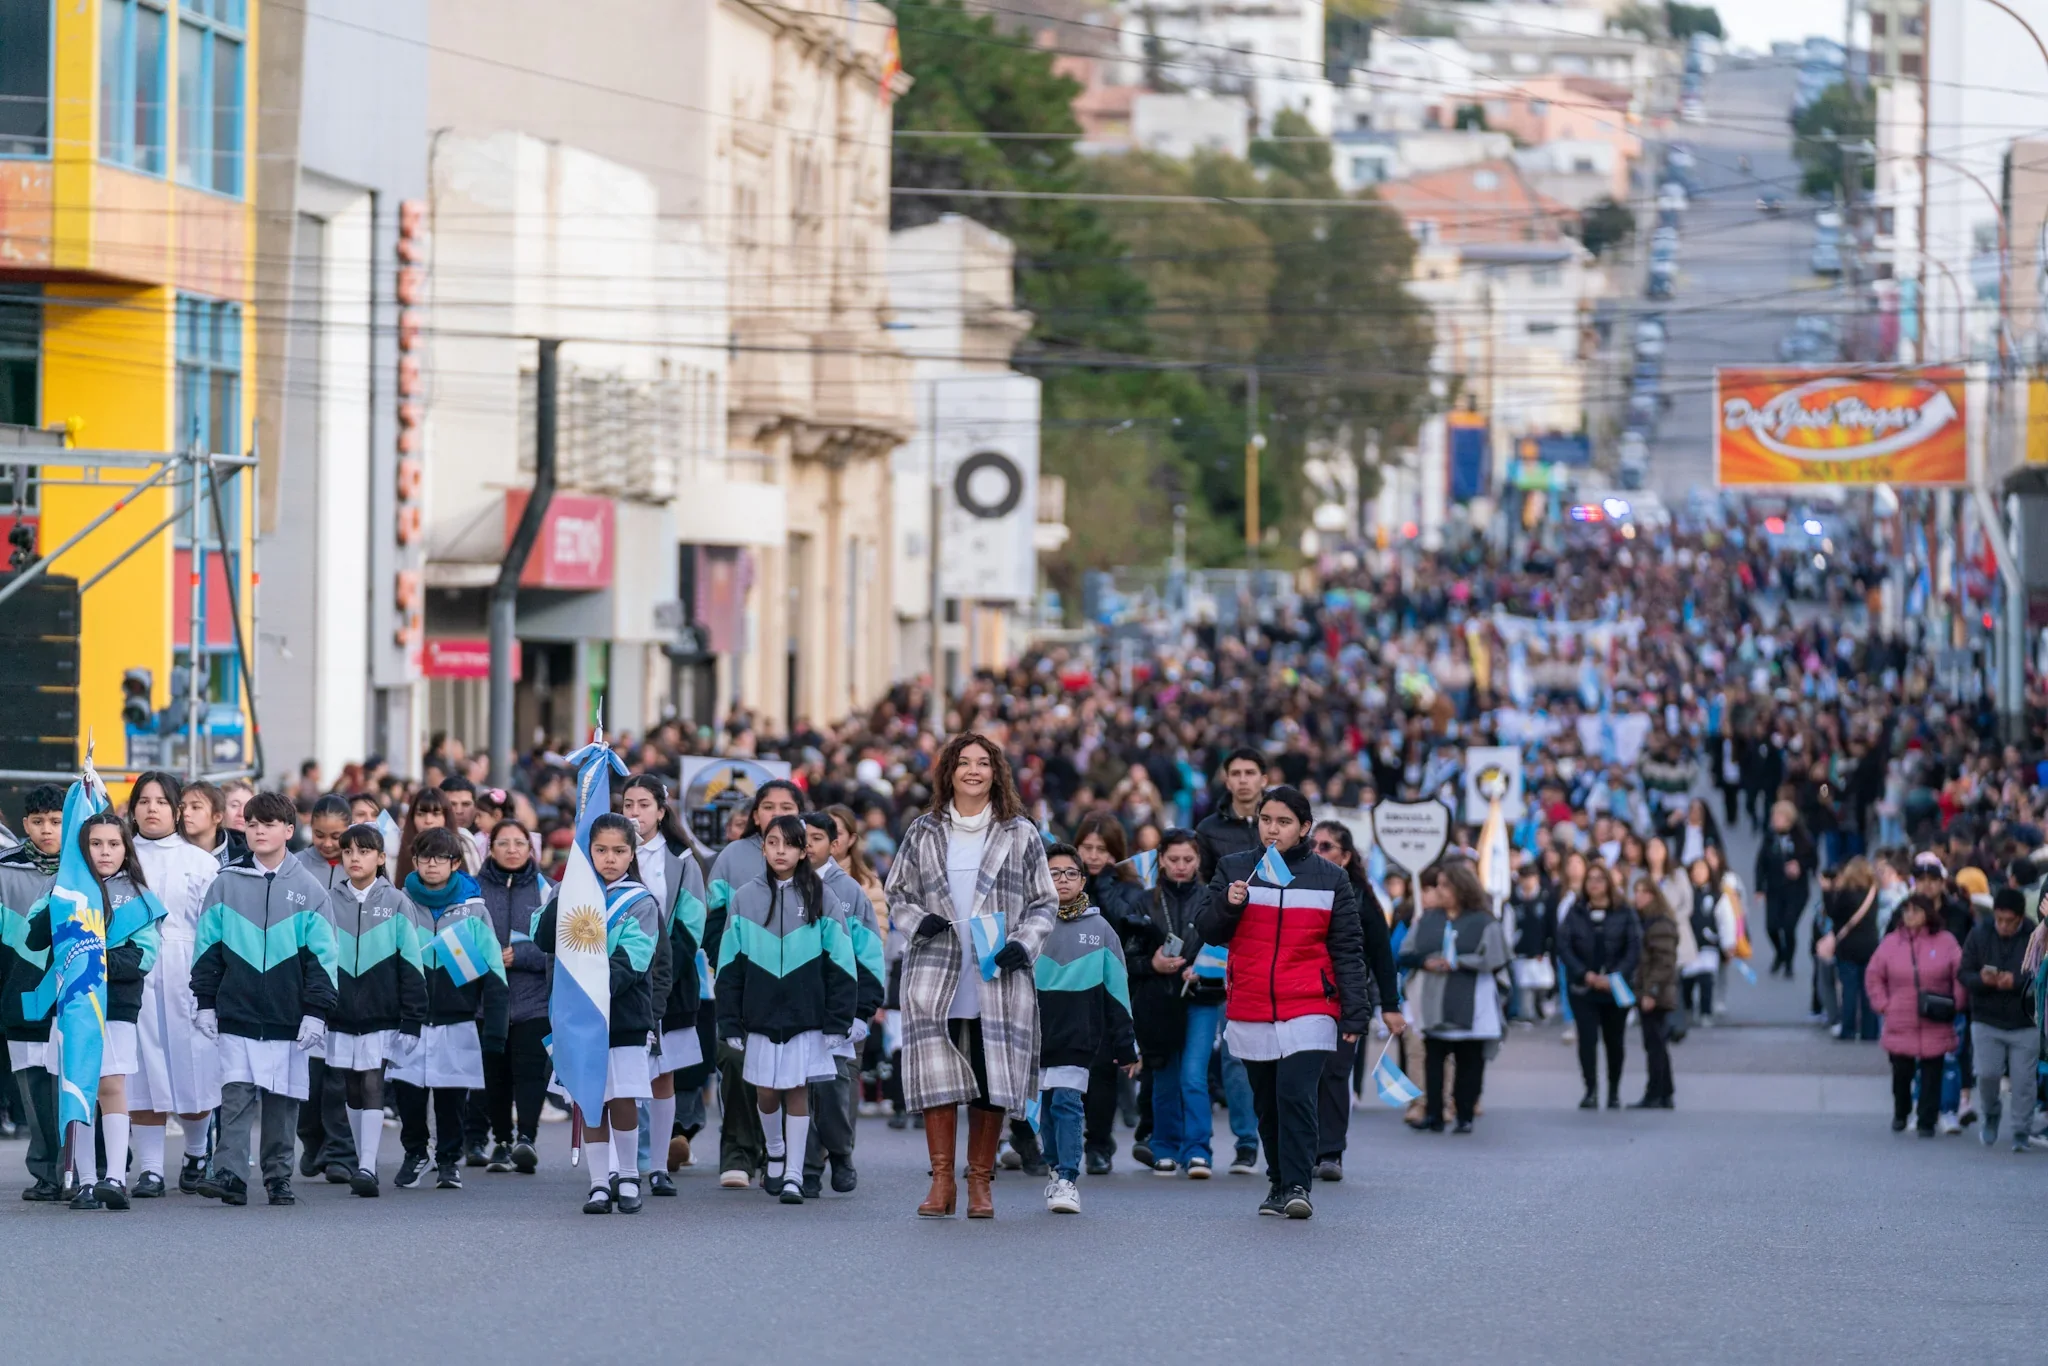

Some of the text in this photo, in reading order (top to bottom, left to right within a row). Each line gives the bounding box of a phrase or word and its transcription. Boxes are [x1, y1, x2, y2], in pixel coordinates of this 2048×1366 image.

[113, 894, 123, 904] E
[285, 889, 307, 906] E 32
[372, 906, 393, 918] E 32
[1078, 933, 1101, 946] E 32
